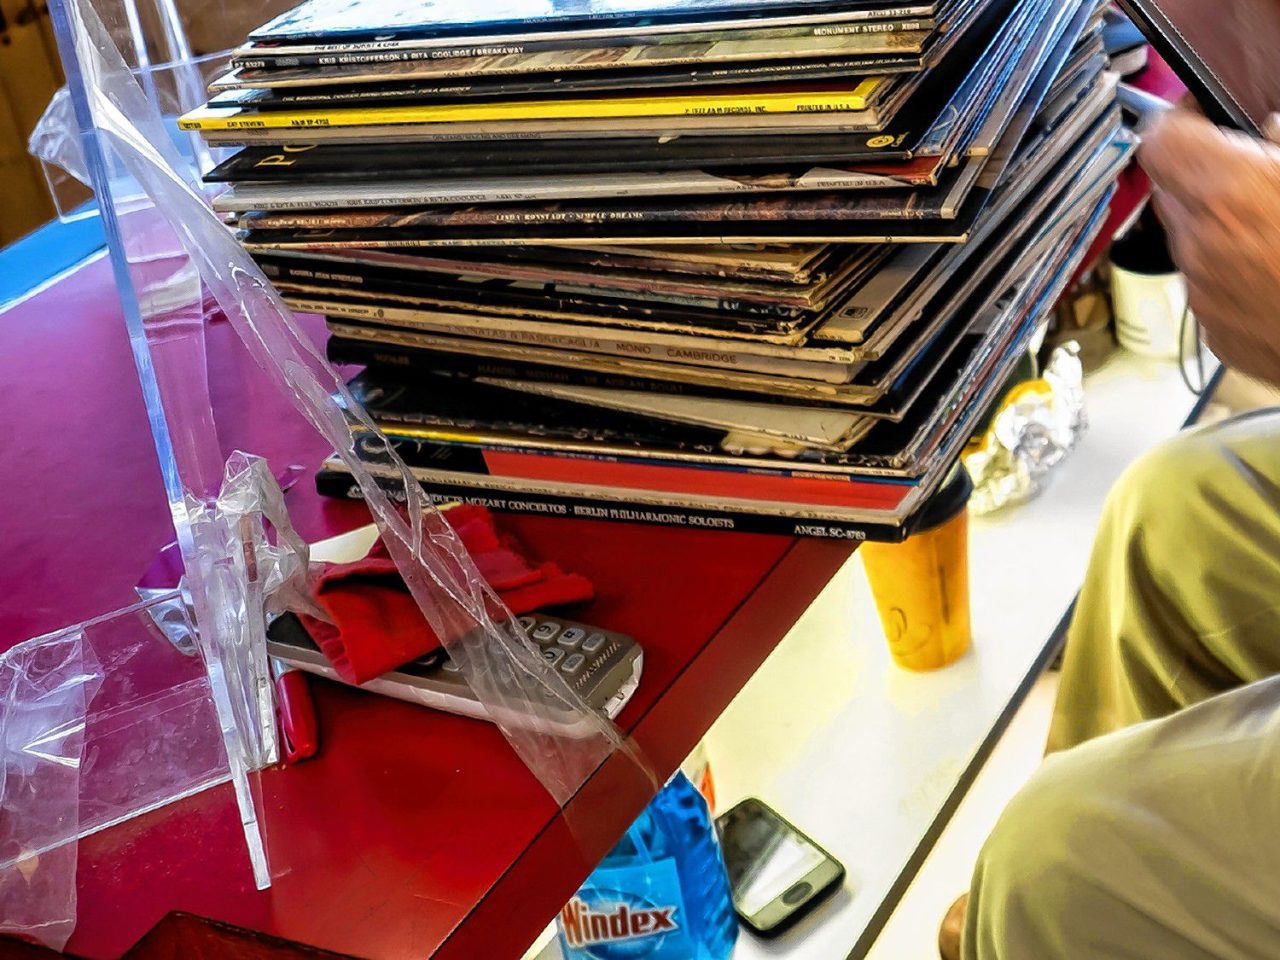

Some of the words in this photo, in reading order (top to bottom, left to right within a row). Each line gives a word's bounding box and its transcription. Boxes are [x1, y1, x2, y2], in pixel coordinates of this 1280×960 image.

[318, 57, 337, 65] KRIS
[338, 54, 400, 64] KRISTOFFERSON
[411, 52, 428, 60] RITA
[813, 25, 859, 36] MONUMENT
[862, 23, 894, 33] STEREO
[575, 212, 607, 220] SIMPLE
[609, 211, 643, 219] DREAMS
[616, 343, 652, 354] MONO
[666, 348, 738, 364] CAMBRIDGE
[465, 496, 505, 509] MOZART
[507, 501, 567, 514] CONCERTOS
[573, 506, 609, 518] BERLIN
[609, 508, 687, 525] PHILHARMONIC
[687, 516, 735, 529] SOLOISTS
[793, 524, 829, 538] ANGEL
[561, 897, 678, 947] Windex
